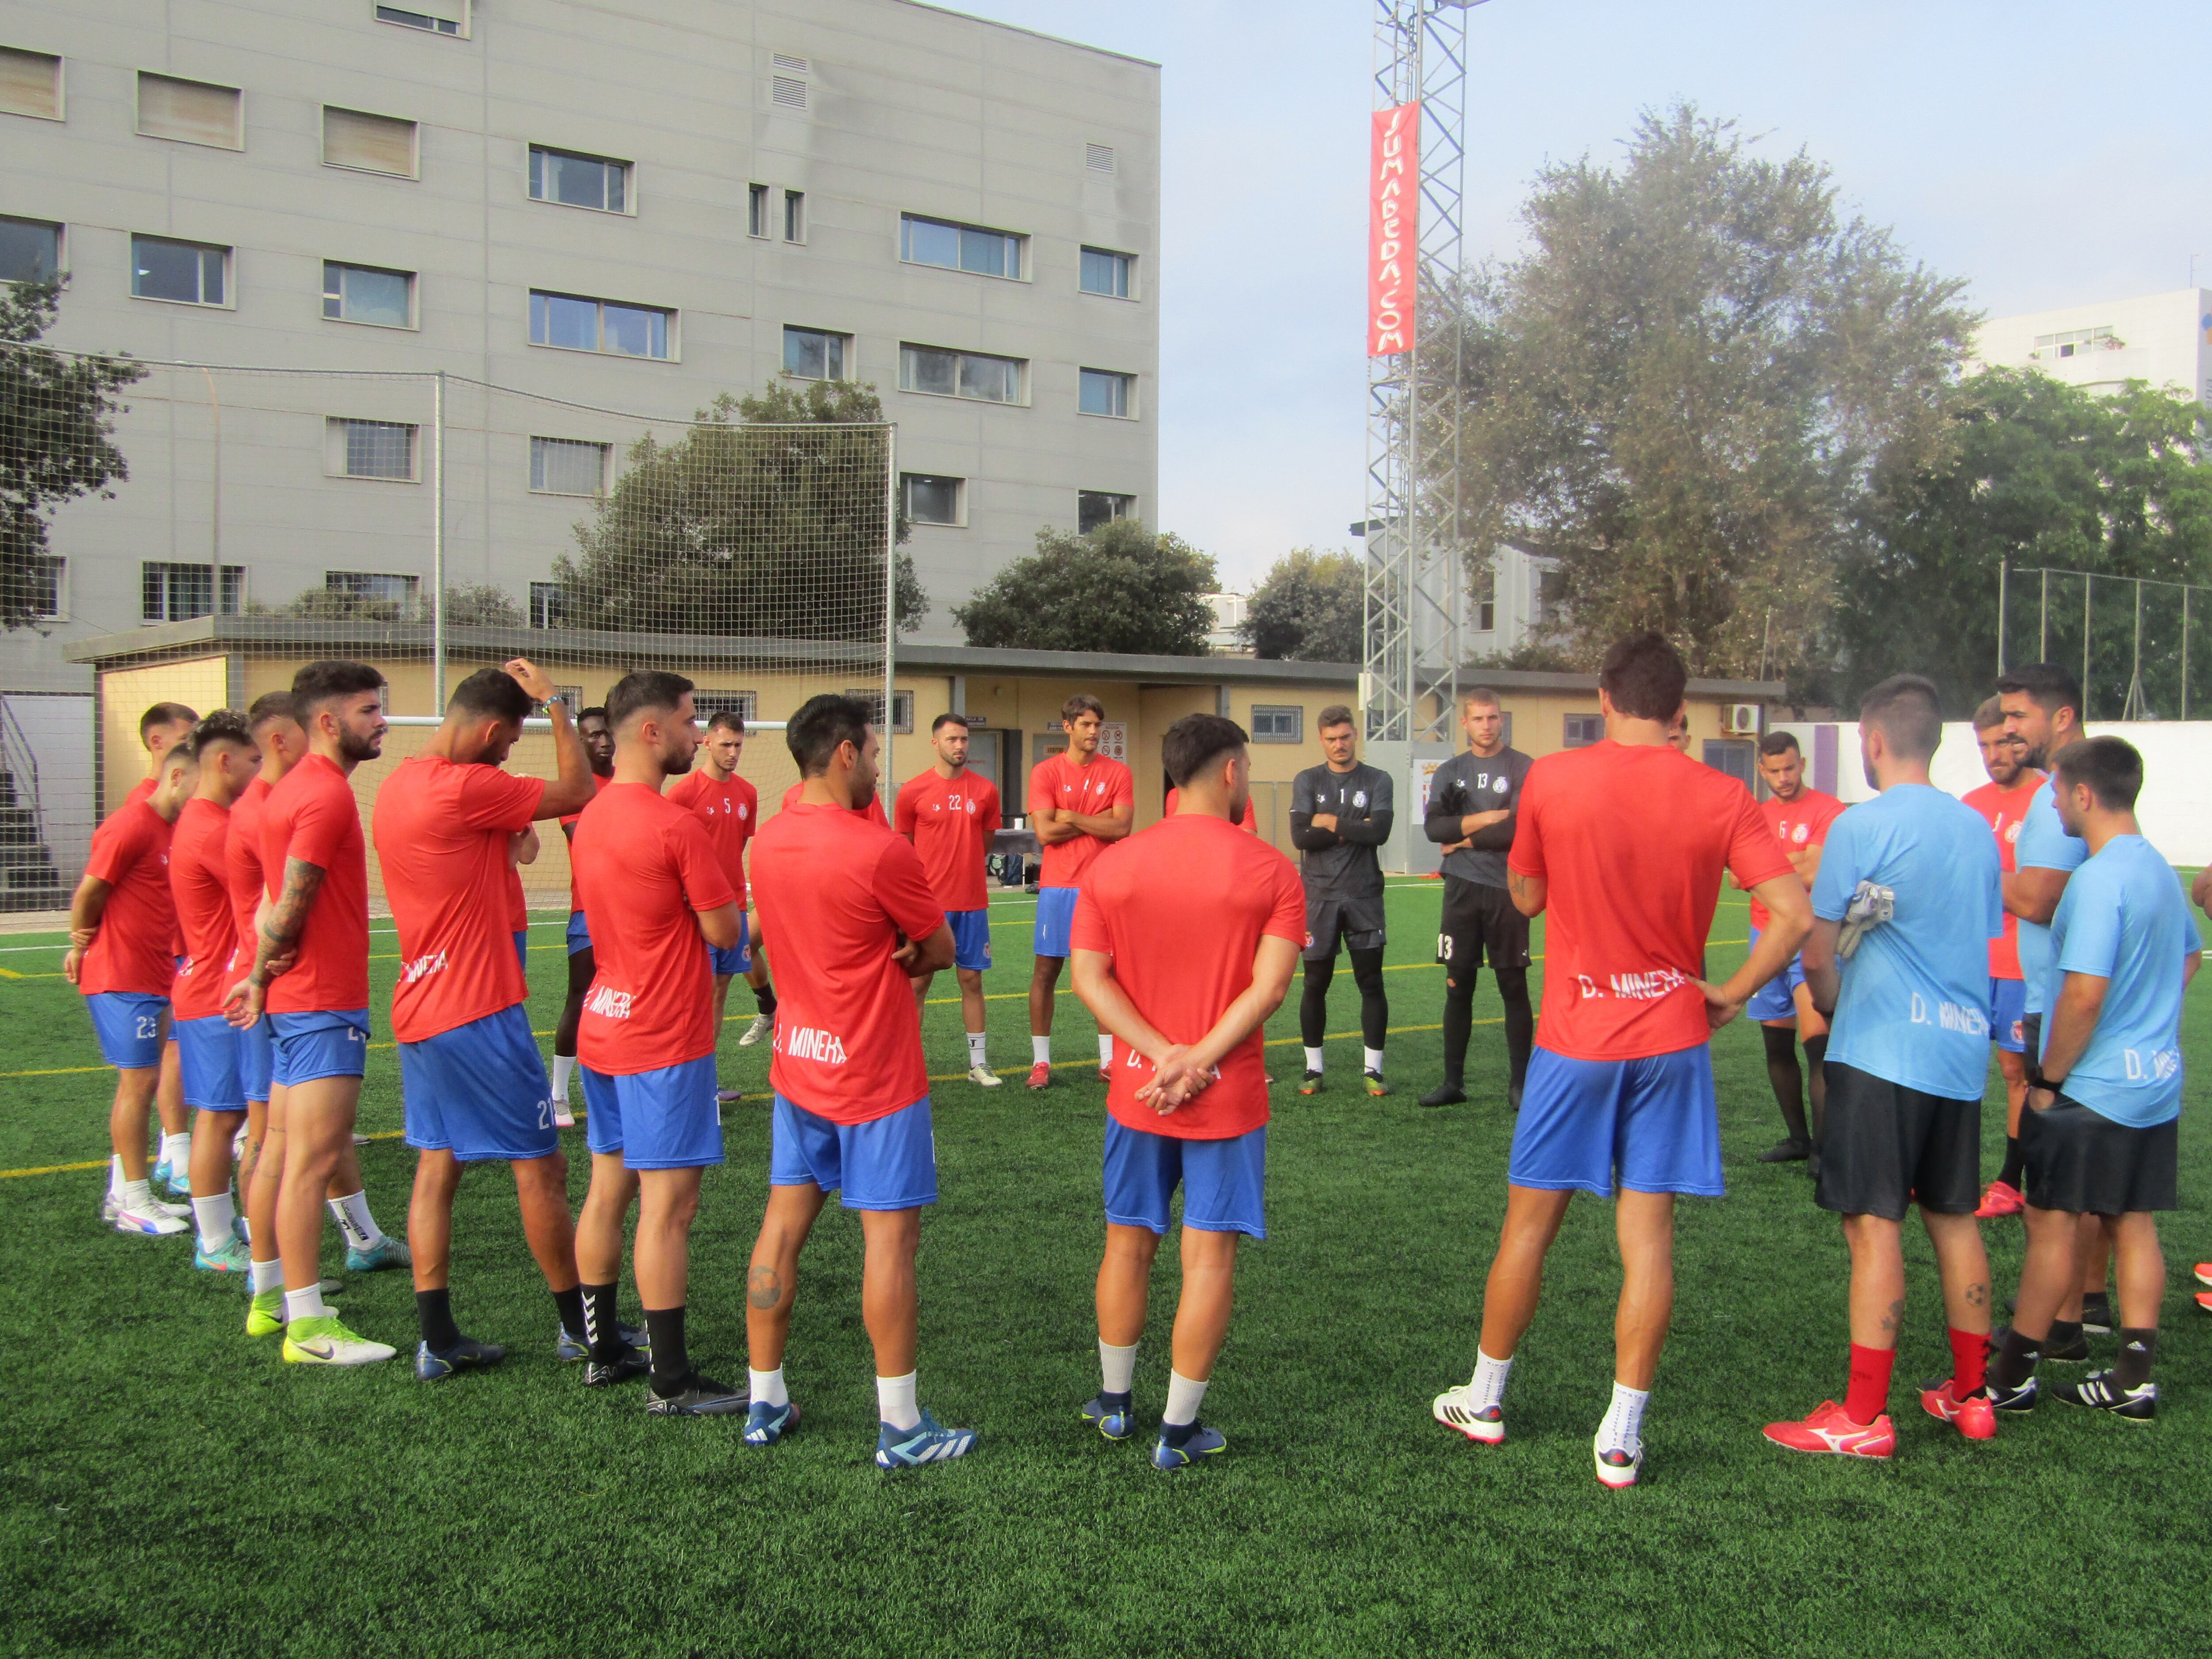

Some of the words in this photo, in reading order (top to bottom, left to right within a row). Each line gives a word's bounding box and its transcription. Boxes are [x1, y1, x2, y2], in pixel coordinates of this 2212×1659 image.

[1478, 773, 1488, 788] 13
[724, 798, 731, 814] 5
[949, 795, 961, 810] 22
[1340, 788, 1344, 803] 1
[1779, 821, 1786, 839] 6
[1437, 933, 1452, 960] 13
[1578, 974, 1603, 998] D.
[1911, 992, 1932, 1025] D.
[136, 1016, 157, 1039] 23
[788, 1025, 847, 1064] MINERA
[2124, 1049, 2148, 1079] D.
[538, 1097, 554, 1130] 21
